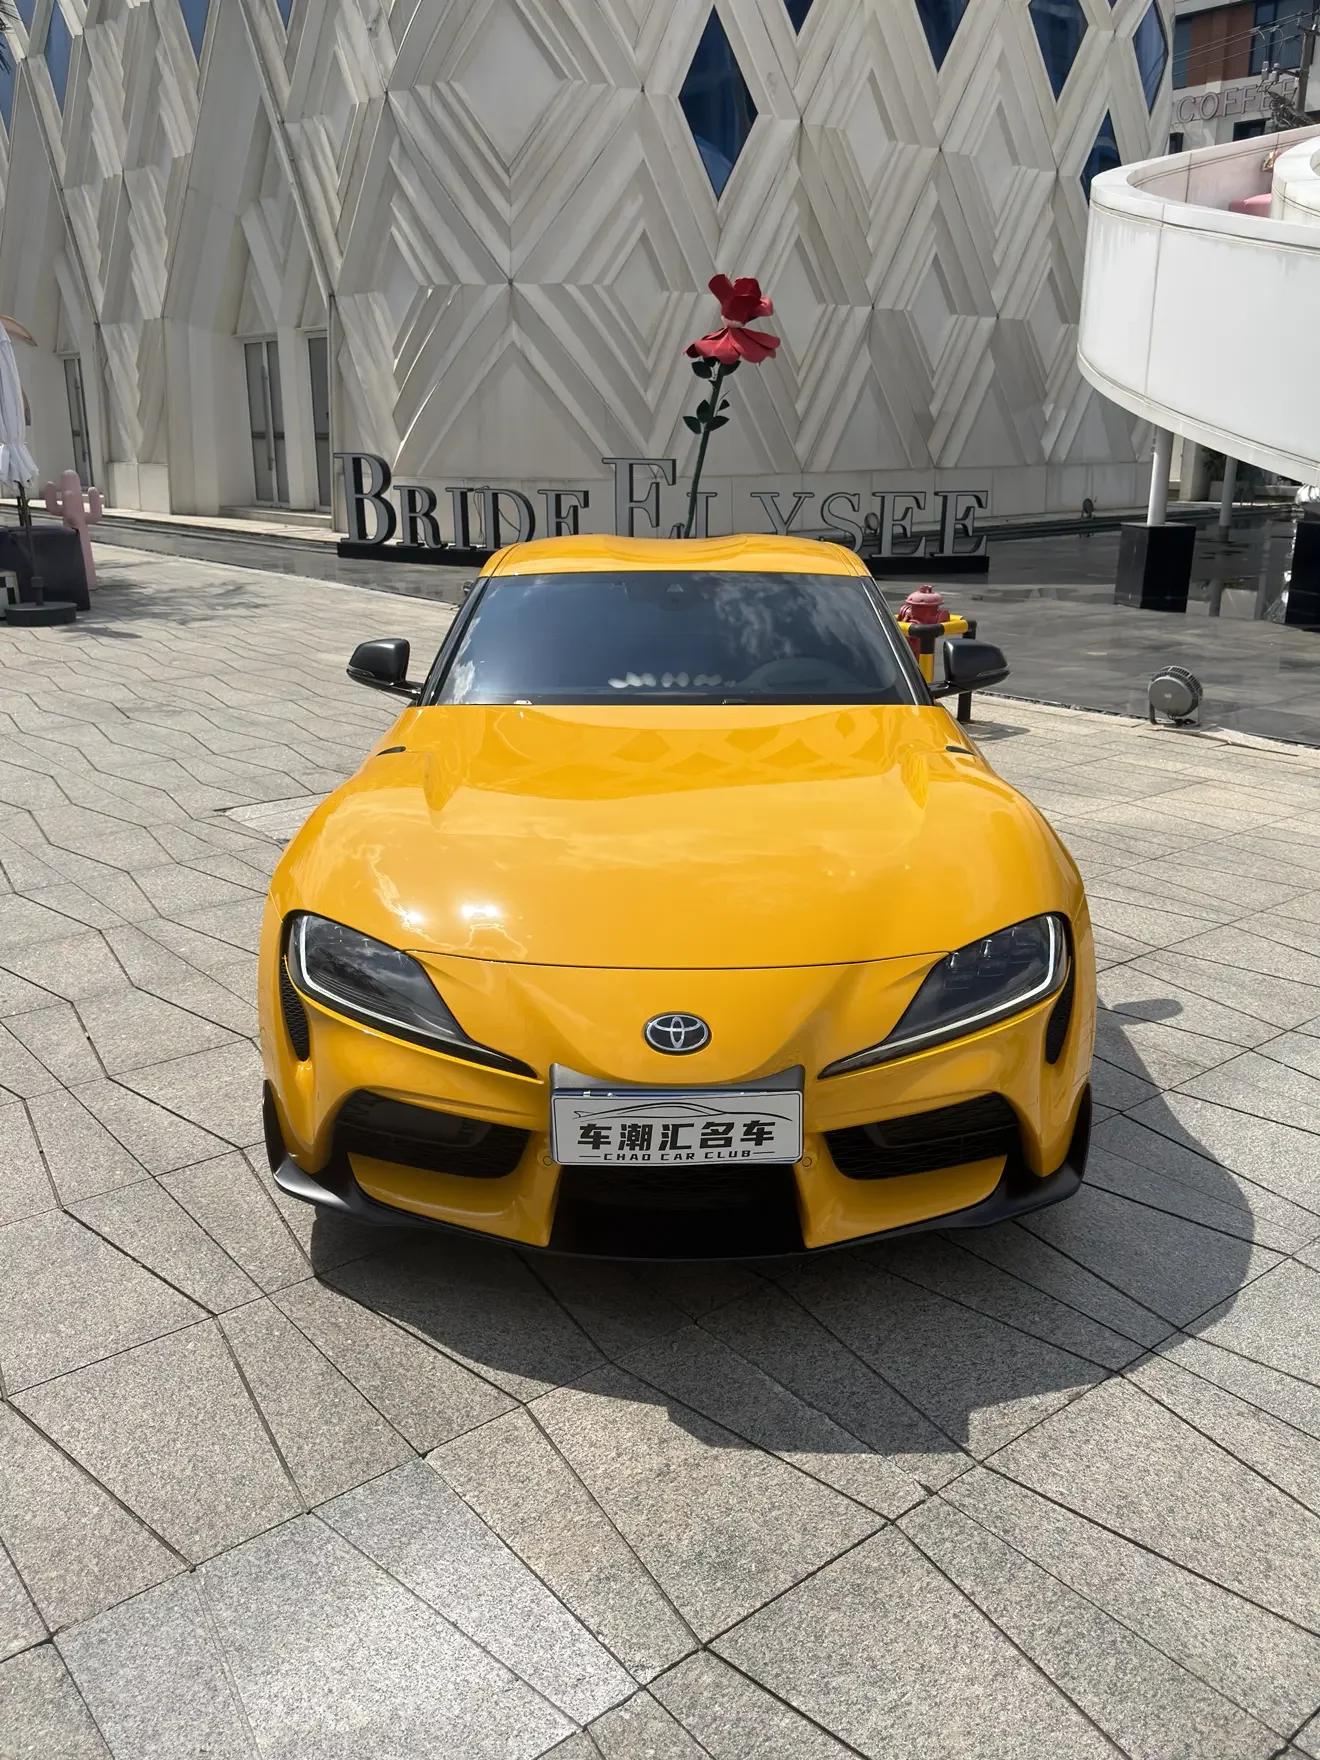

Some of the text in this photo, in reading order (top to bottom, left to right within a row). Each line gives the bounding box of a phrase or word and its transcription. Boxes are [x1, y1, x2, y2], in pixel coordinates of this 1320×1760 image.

[334, 452, 590, 549] BRIDE
[577, 1119, 776, 1151] 车潮汇名车
[603, 1150, 751, 1161] CHAO CAR CLUB
